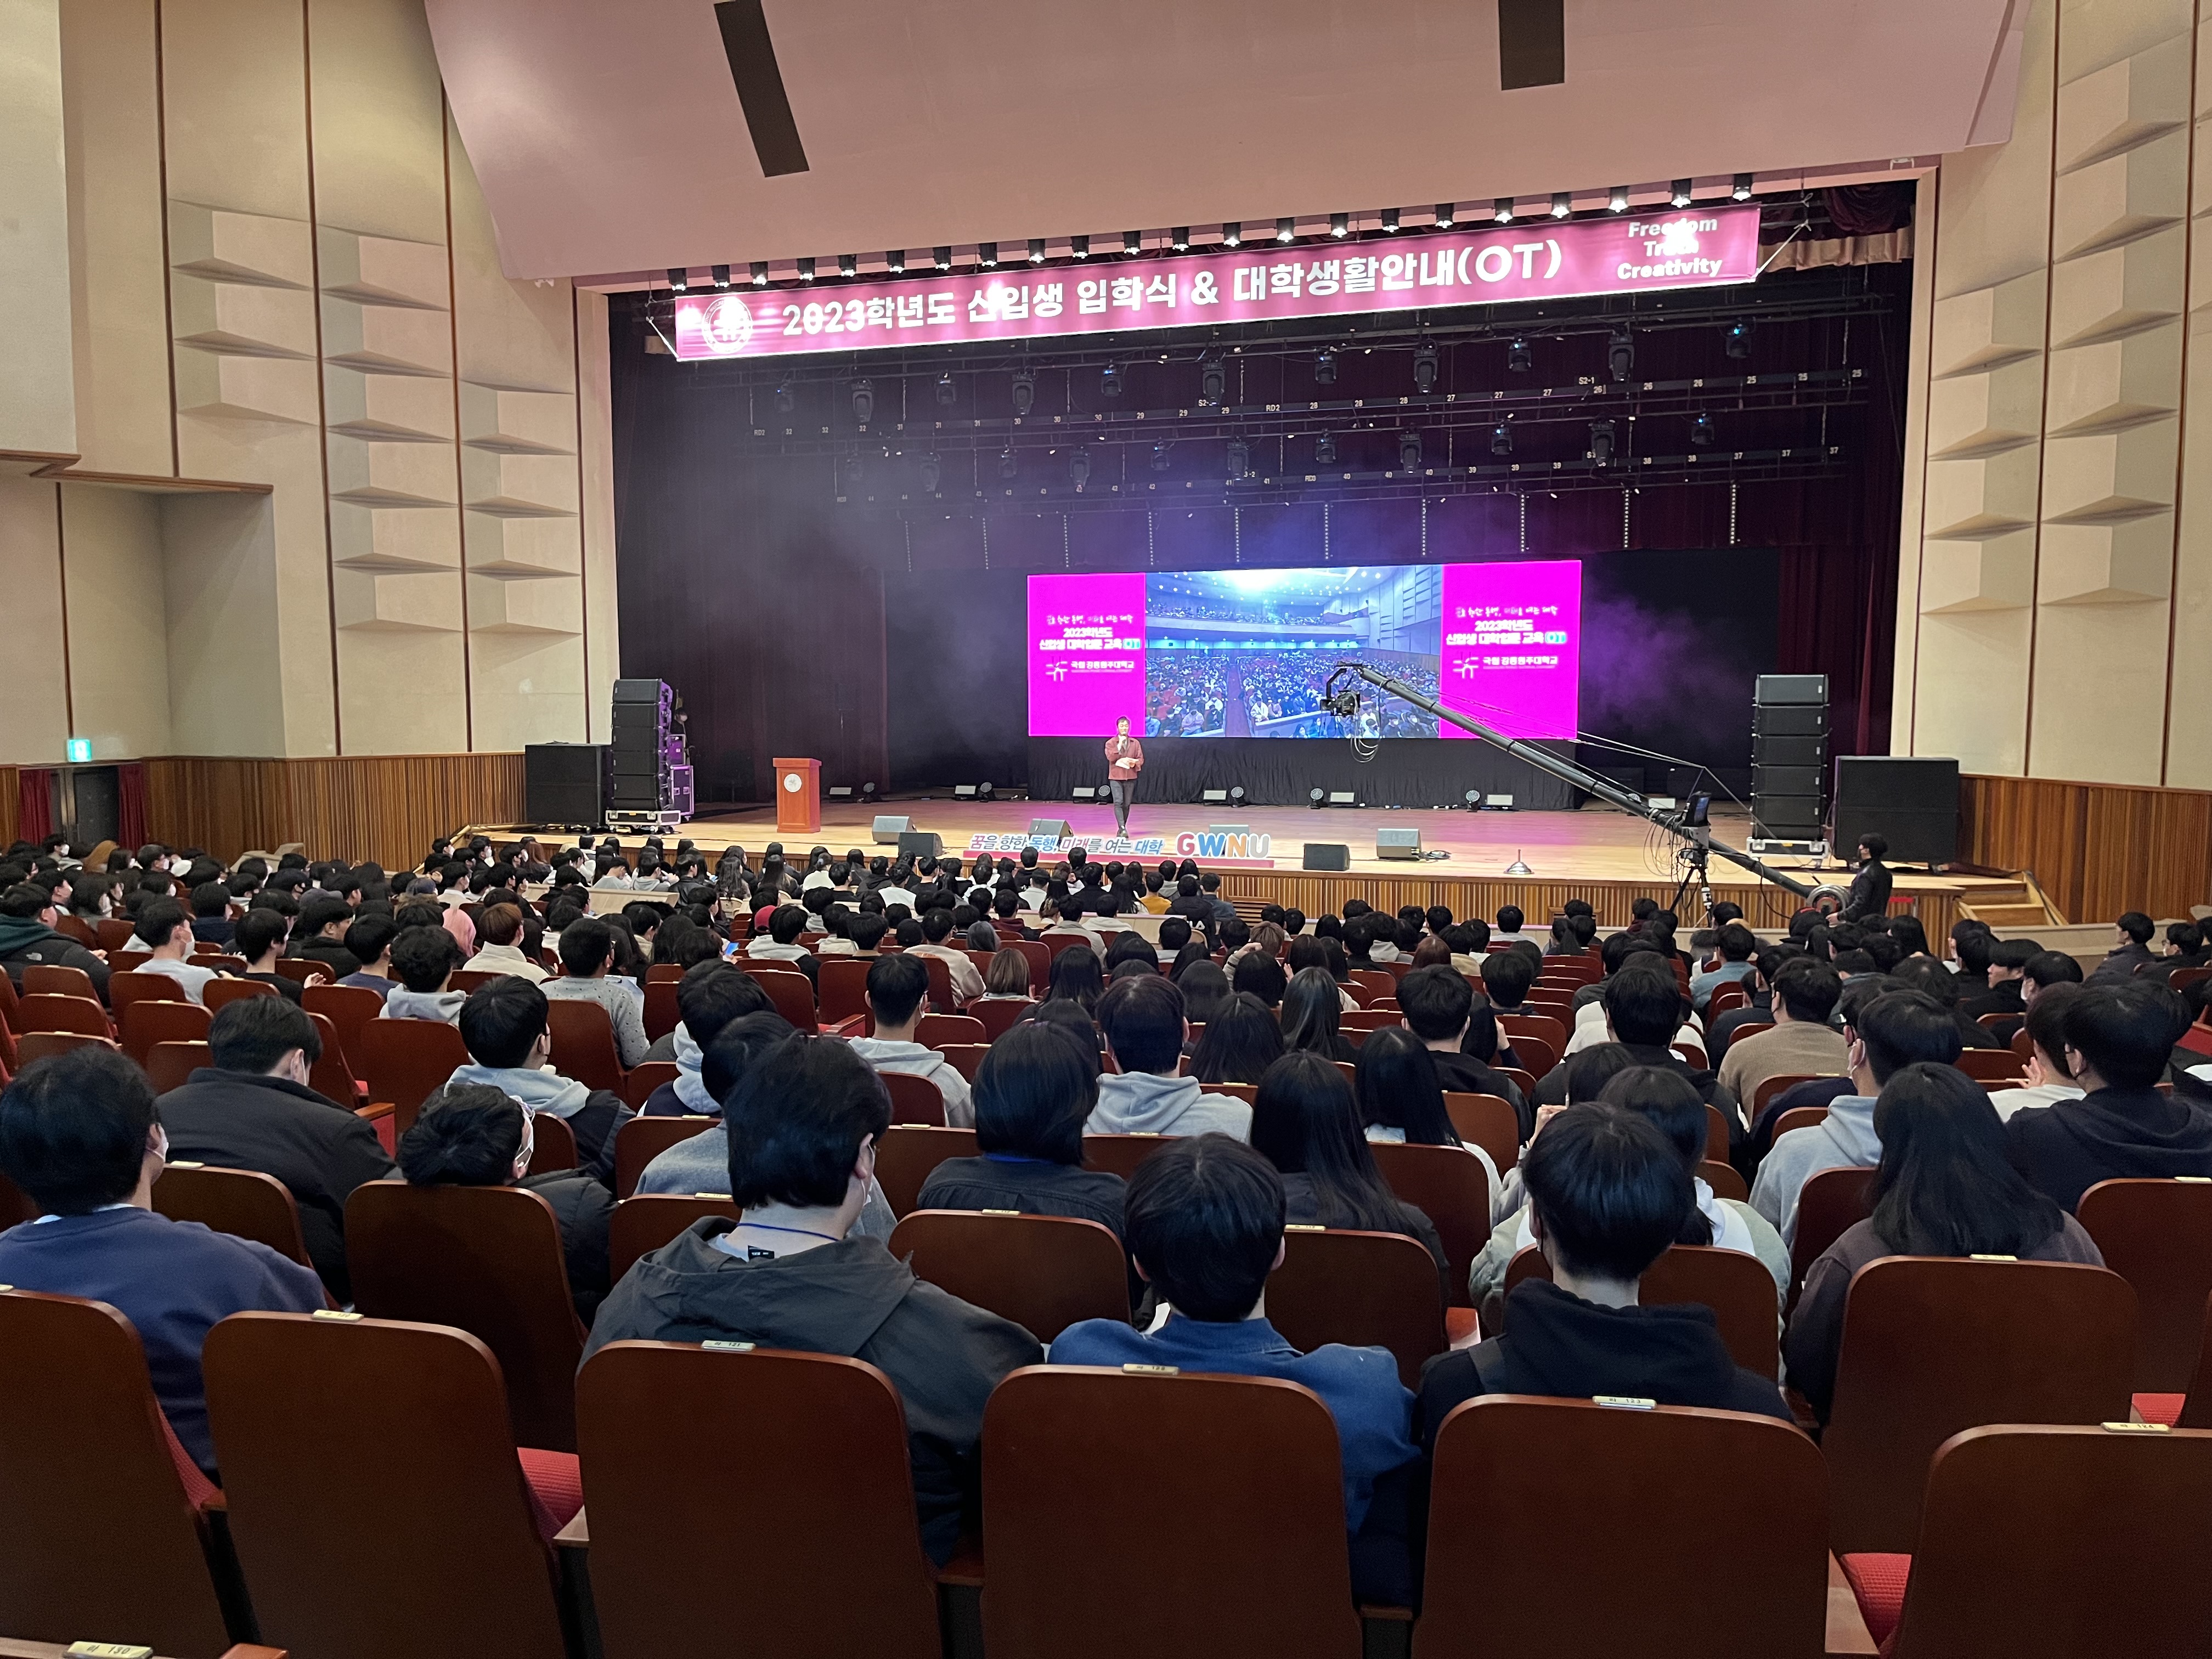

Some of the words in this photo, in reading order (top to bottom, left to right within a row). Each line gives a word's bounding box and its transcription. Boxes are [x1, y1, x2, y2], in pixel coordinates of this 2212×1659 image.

[1617, 257, 1723, 279] Creativity
[783, 292, 956, 335] 2023학년도
[968, 283, 1063, 323] 신입생
[1077, 273, 1176, 314] 입학식
[1191, 271, 1218, 304] &
[1233, 239, 1562, 301] 대학생활안내(OT)
[1747, 376, 1756, 384] 25
[970, 835, 997, 850] 꿈을
[1000, 835, 1027, 850] 향한
[1062, 837, 1102, 853] 미래를
[1105, 837, 1132, 854] 여는
[1135, 839, 1164, 855] 대학
[1177, 833, 1270, 858] GWNU
